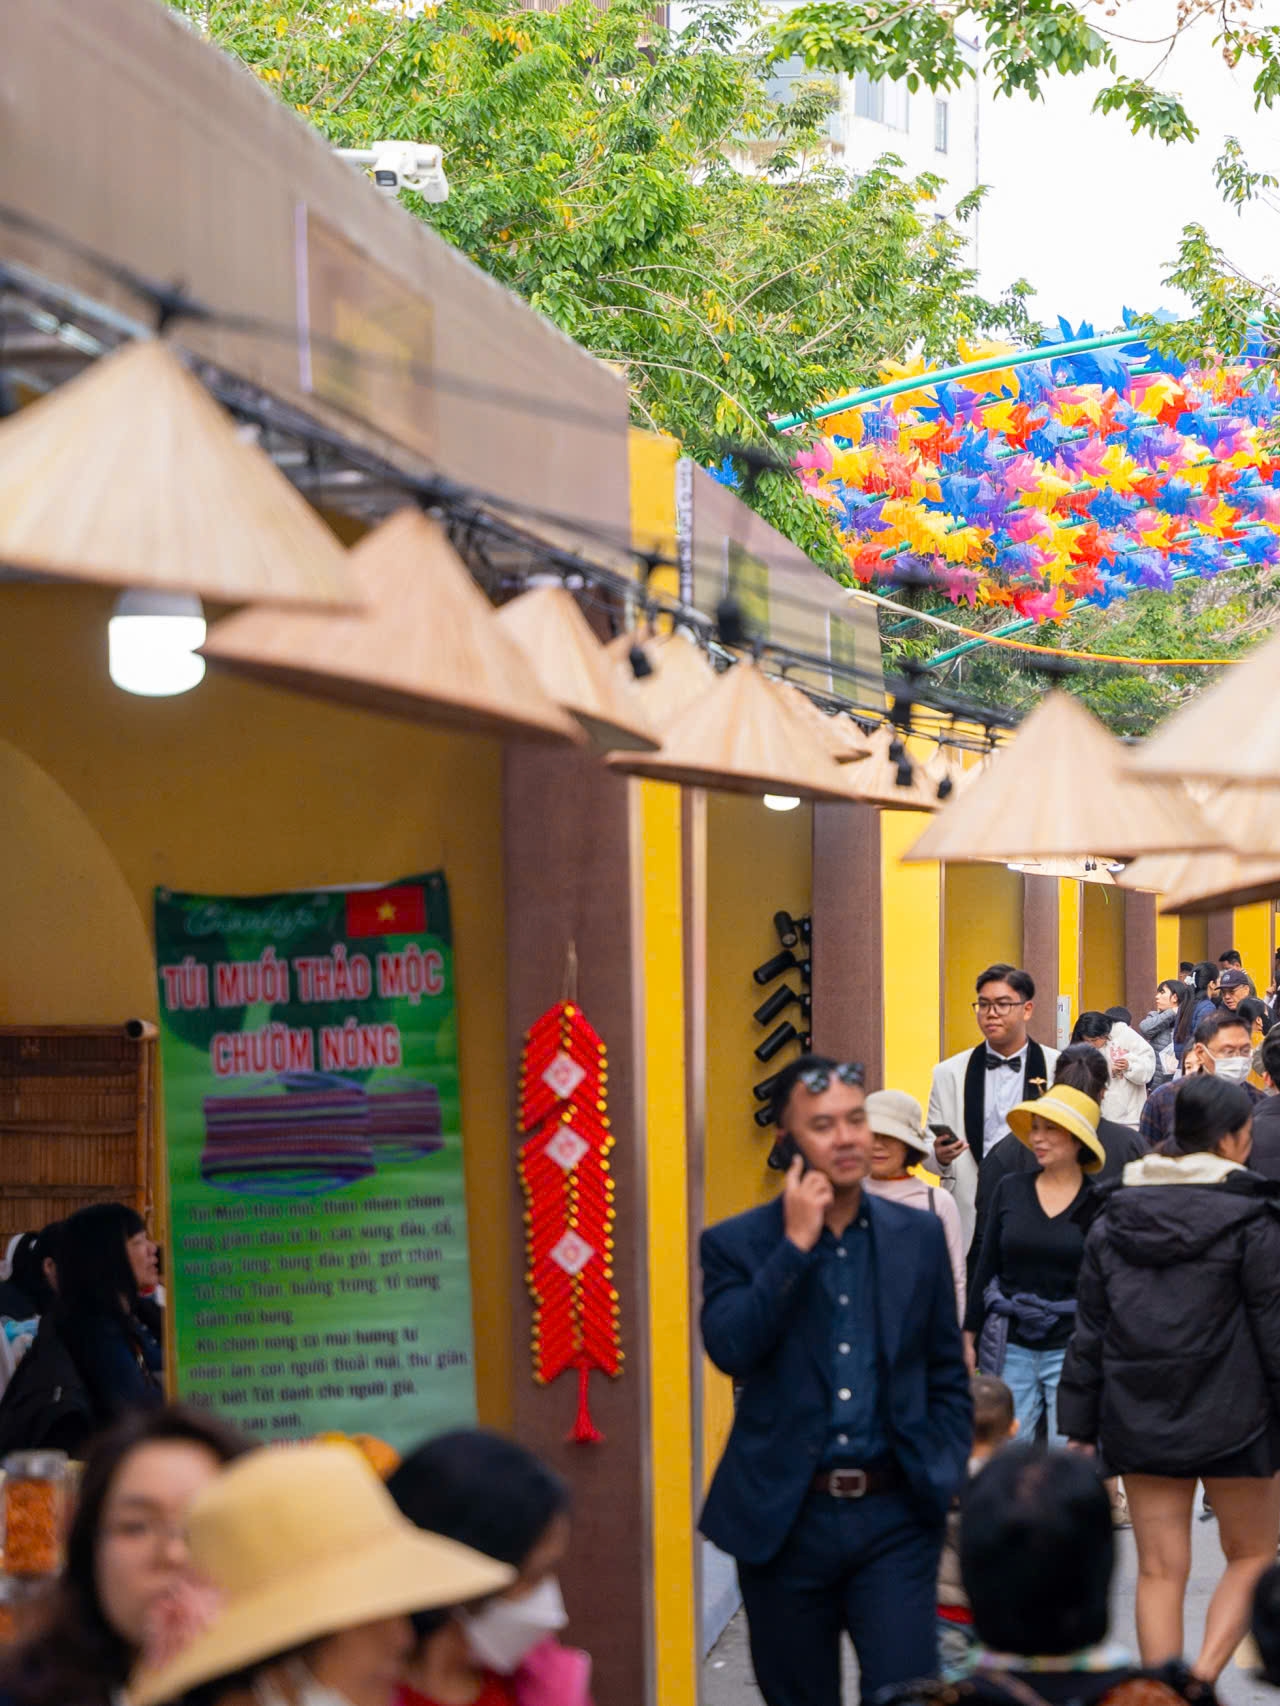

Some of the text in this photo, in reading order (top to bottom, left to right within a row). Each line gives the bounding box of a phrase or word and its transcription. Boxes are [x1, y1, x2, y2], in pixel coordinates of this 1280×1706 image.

[215, 944, 289, 1006] MUỐI
[294, 942, 371, 1001] THẢO
[377, 943, 444, 1005] MỘC
[319, 1017, 402, 1070] NÓNG
